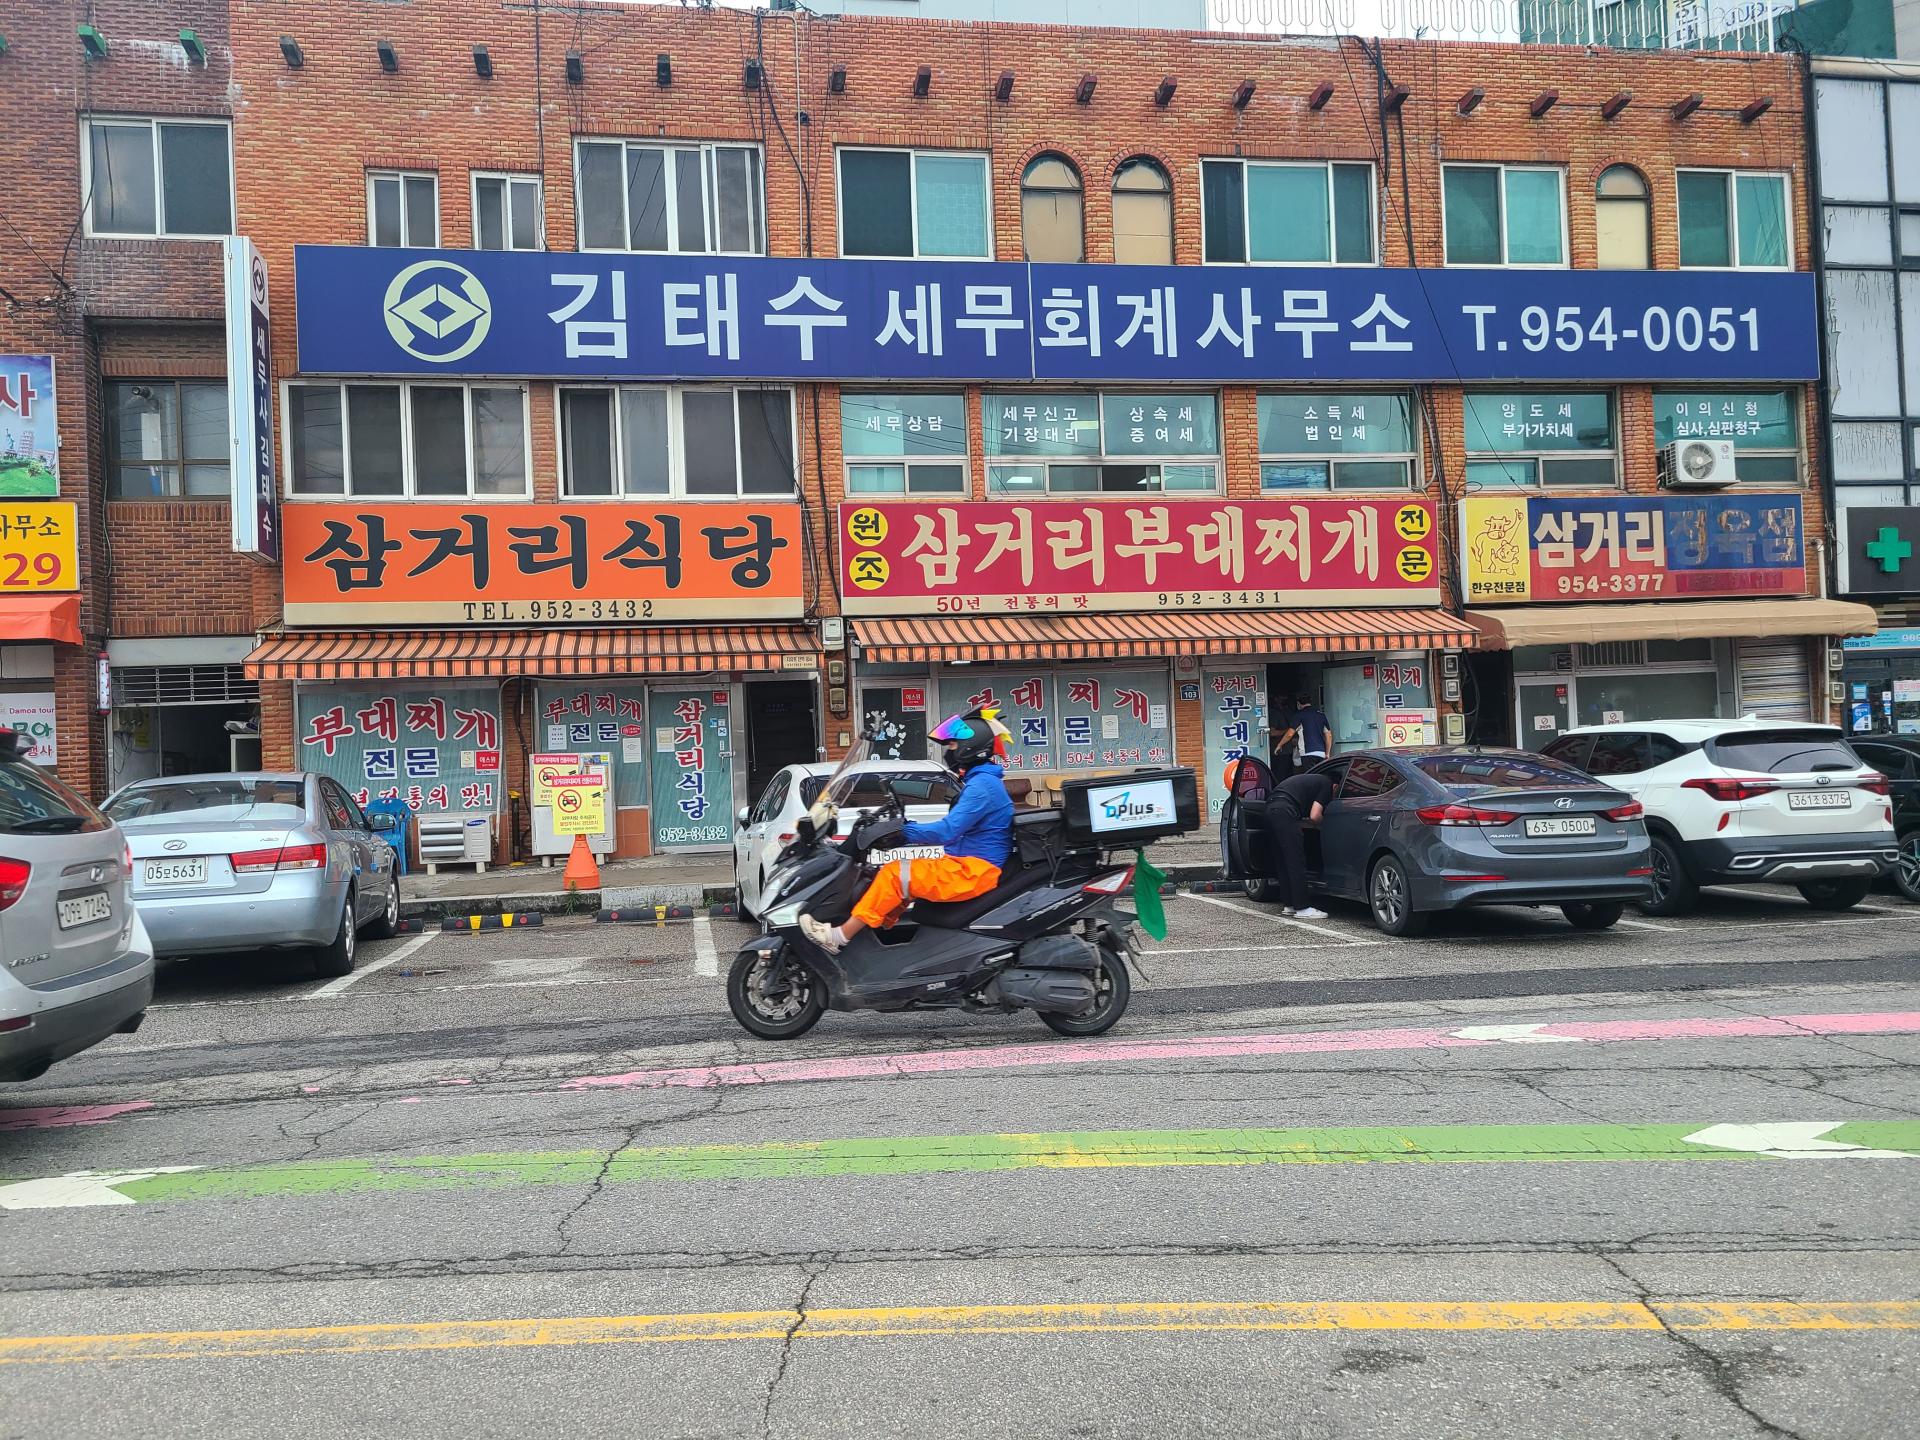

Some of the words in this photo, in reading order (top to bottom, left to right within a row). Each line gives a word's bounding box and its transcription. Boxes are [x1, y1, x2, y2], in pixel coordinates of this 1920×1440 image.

[548, 270, 847, 361] 김태수
[875, 282, 1414, 359] 세무회계사무소
[0, 372, 37, 419] 사
[1003, 406, 1078, 422] 세무신고
[1130, 406, 1192, 422] 상속세
[1304, 405, 1365, 421] 소득세
[1502, 402, 1572, 419] 양도세
[1676, 401, 1757, 417] 이의신청
[866, 415, 942, 432] 세무상담
[1305, 423, 1366, 441] 법인세
[1502, 421, 1573, 438] 부가가치세
[1676, 420, 1762, 437] 심사,심판청구
[1004, 427, 1079, 443] 기장대리
[1130, 426, 1193, 443] 증여세
[852, 512, 886, 585] 원조
[901, 505, 1380, 588] 삼거리부대찌개
[1398, 509, 1429, 578] 전문
[1533, 511, 1665, 568] 삼거리
[304, 513, 788, 593] 삼거리식당
[3, 553, 61, 585] 29
[1471, 581, 1526, 595] 한우전문점
[1557, 574, 1664, 594] 954-3377
[936, 596, 981, 612] 50년
[1003, 595, 1059, 611] 전통의
[1073, 593, 1089, 609] 맛
[1158, 592, 1281, 608] 952-3431
[464, 600, 654, 620] TEL.952-3432
[1211, 675, 1257, 693] 삼거리
[9, 707, 36, 715] Damoa
[543, 692, 642, 724] 부대찌개
[967, 678, 1149, 725] 부대찌개
[303, 697, 498, 757] 부대찌개
[570, 722, 619, 743] 전문
[1021, 716, 1092, 747] 전문
[1218, 695, 1251, 764] 부대찌
[363, 747, 439, 780] 전문
[674, 698, 710, 821] 삼거리식당
[1067, 751, 1095, 765] 50년
[1103, 748, 1141, 764] 전통의
[461, 782, 493, 811] 맛!
[659, 826, 727, 842] 952-3432
[1562, 820, 1590, 832] 0500
[911, 847, 942, 860] 1425
